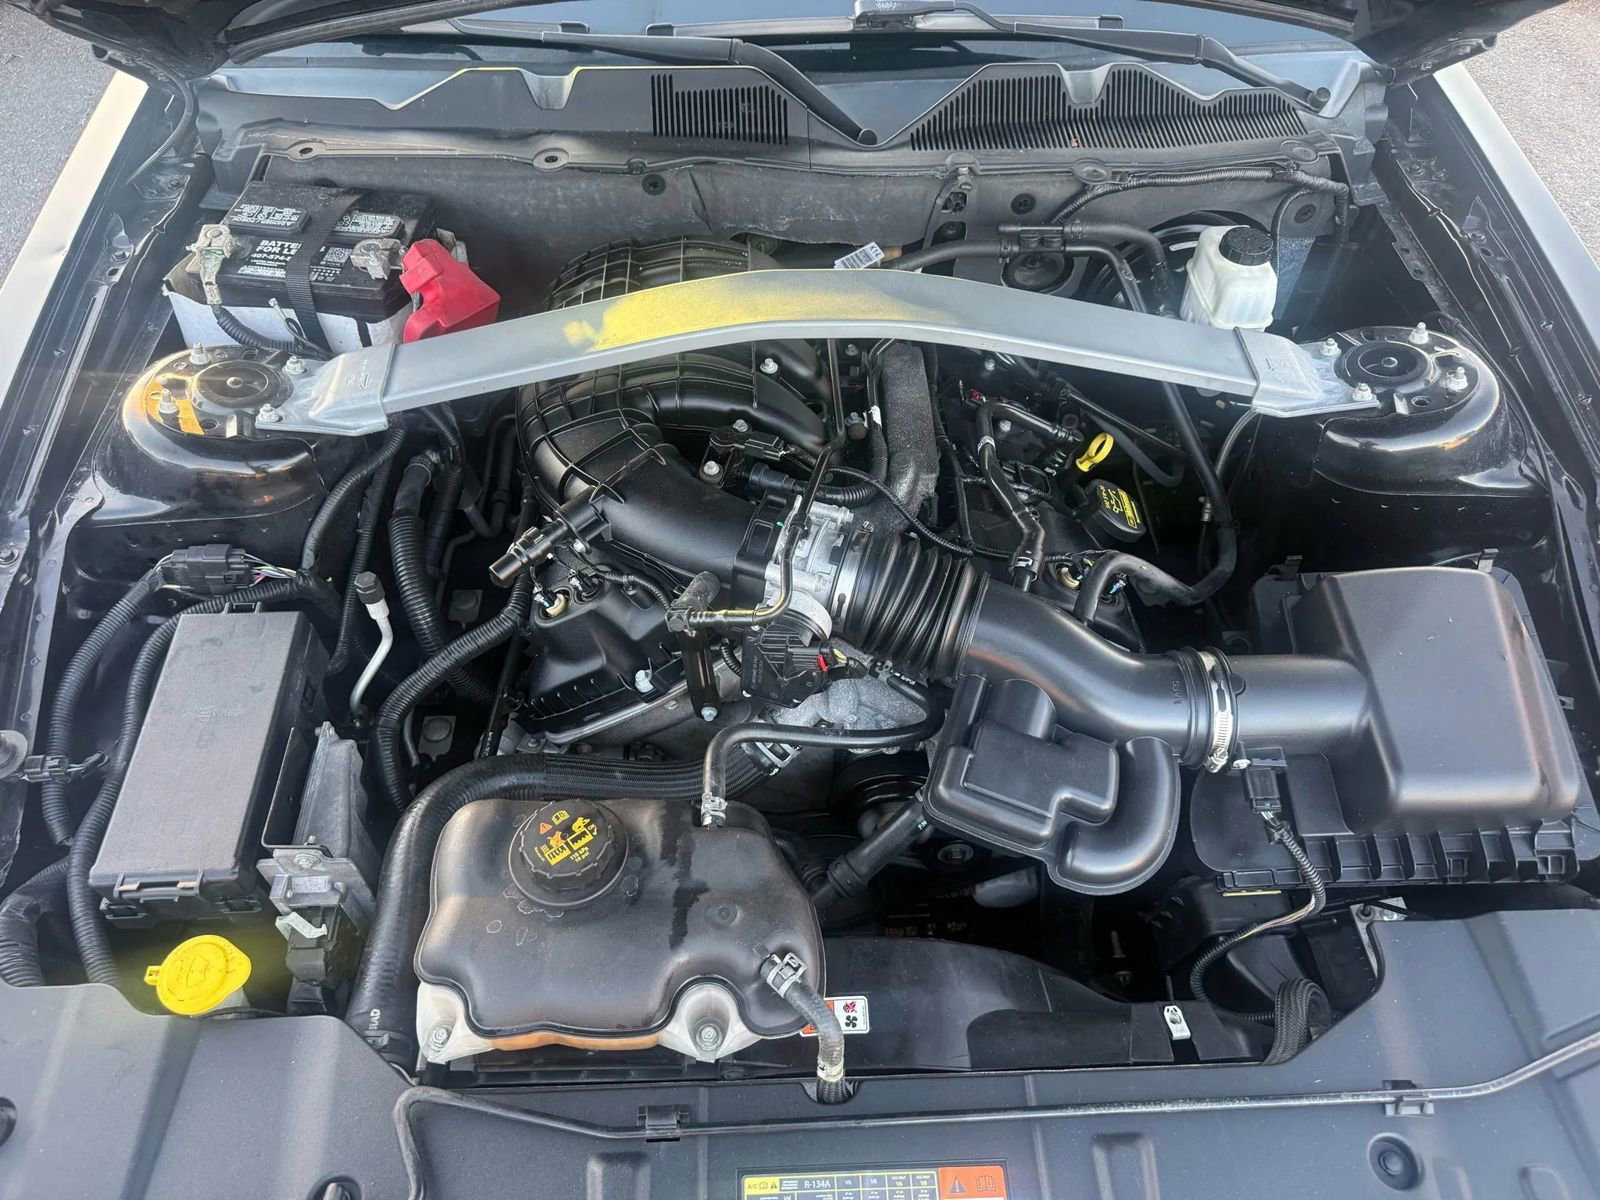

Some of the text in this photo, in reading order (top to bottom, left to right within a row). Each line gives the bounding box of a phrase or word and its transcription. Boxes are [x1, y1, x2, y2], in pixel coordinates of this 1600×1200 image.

[256, 245, 298, 255] FOR LE
[804, 1180, 831, 1189] R-134A
